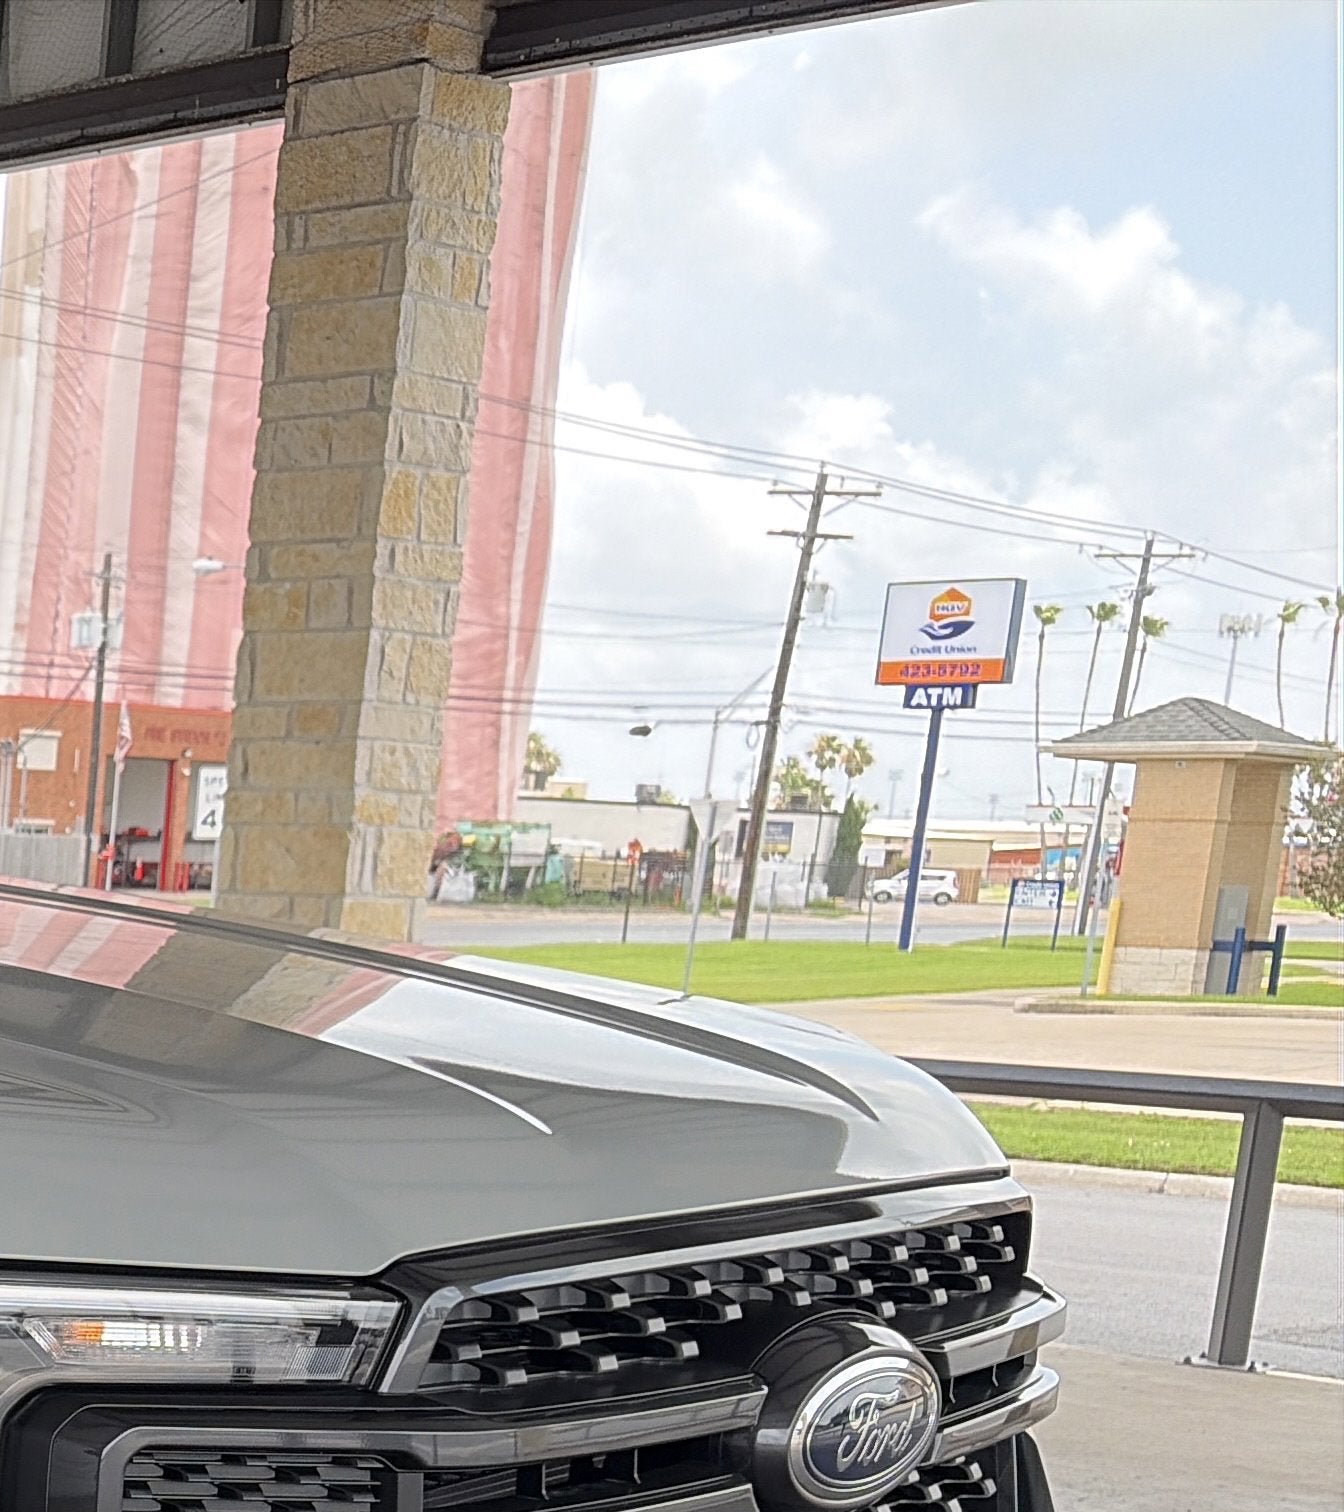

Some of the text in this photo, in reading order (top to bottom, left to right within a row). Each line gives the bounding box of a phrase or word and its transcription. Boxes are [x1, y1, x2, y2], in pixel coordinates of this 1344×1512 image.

[909, 644, 977, 655] Credit Union
[910, 687, 963, 707] ATM
[201, 809, 216, 828] 4
[836, 1388, 917, 1473] Ford
